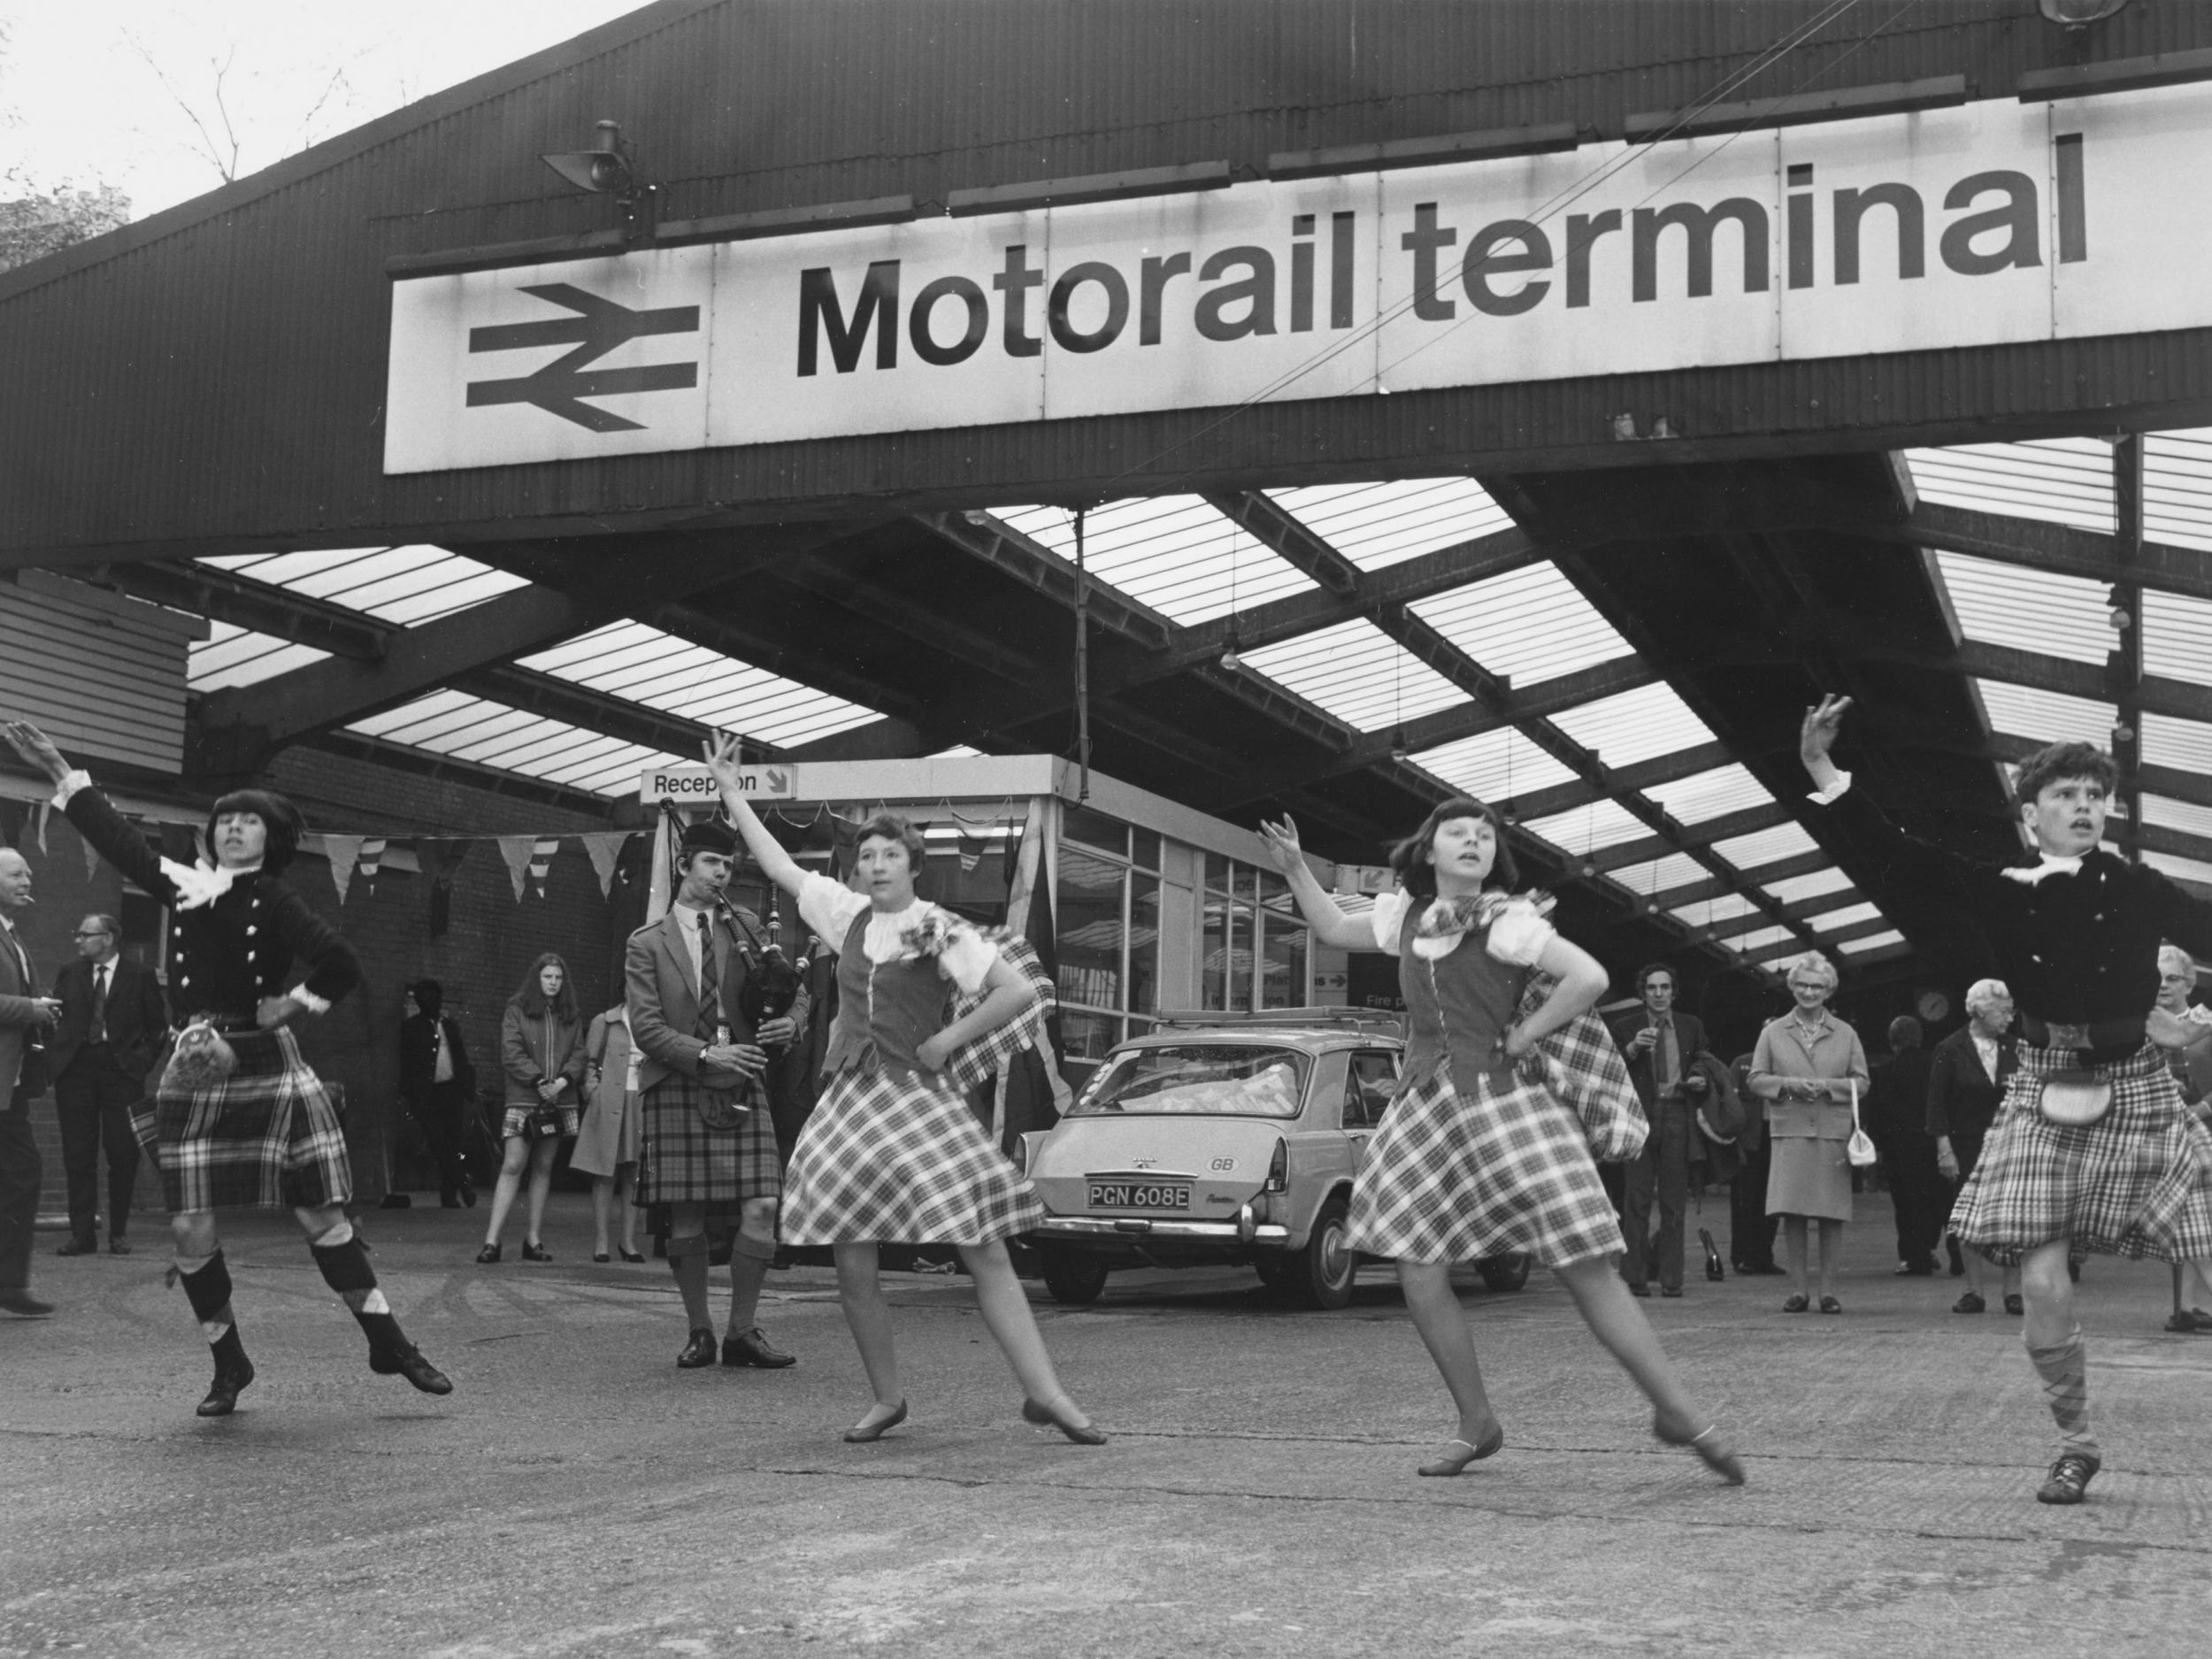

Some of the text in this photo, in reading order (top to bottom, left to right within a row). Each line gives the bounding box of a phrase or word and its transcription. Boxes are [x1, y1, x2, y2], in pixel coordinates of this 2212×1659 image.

[796, 132, 2087, 377] Motorail terminal
[654, 774, 757, 795] Recepn
[1211, 994, 1285, 1006] Inrmion
[1366, 995, 1392, 1007] Fire
[1211, 1158, 1234, 1171] GB
[1090, 1186, 1130, 1205] PGN
[1134, 1187, 1188, 1206] 608E
